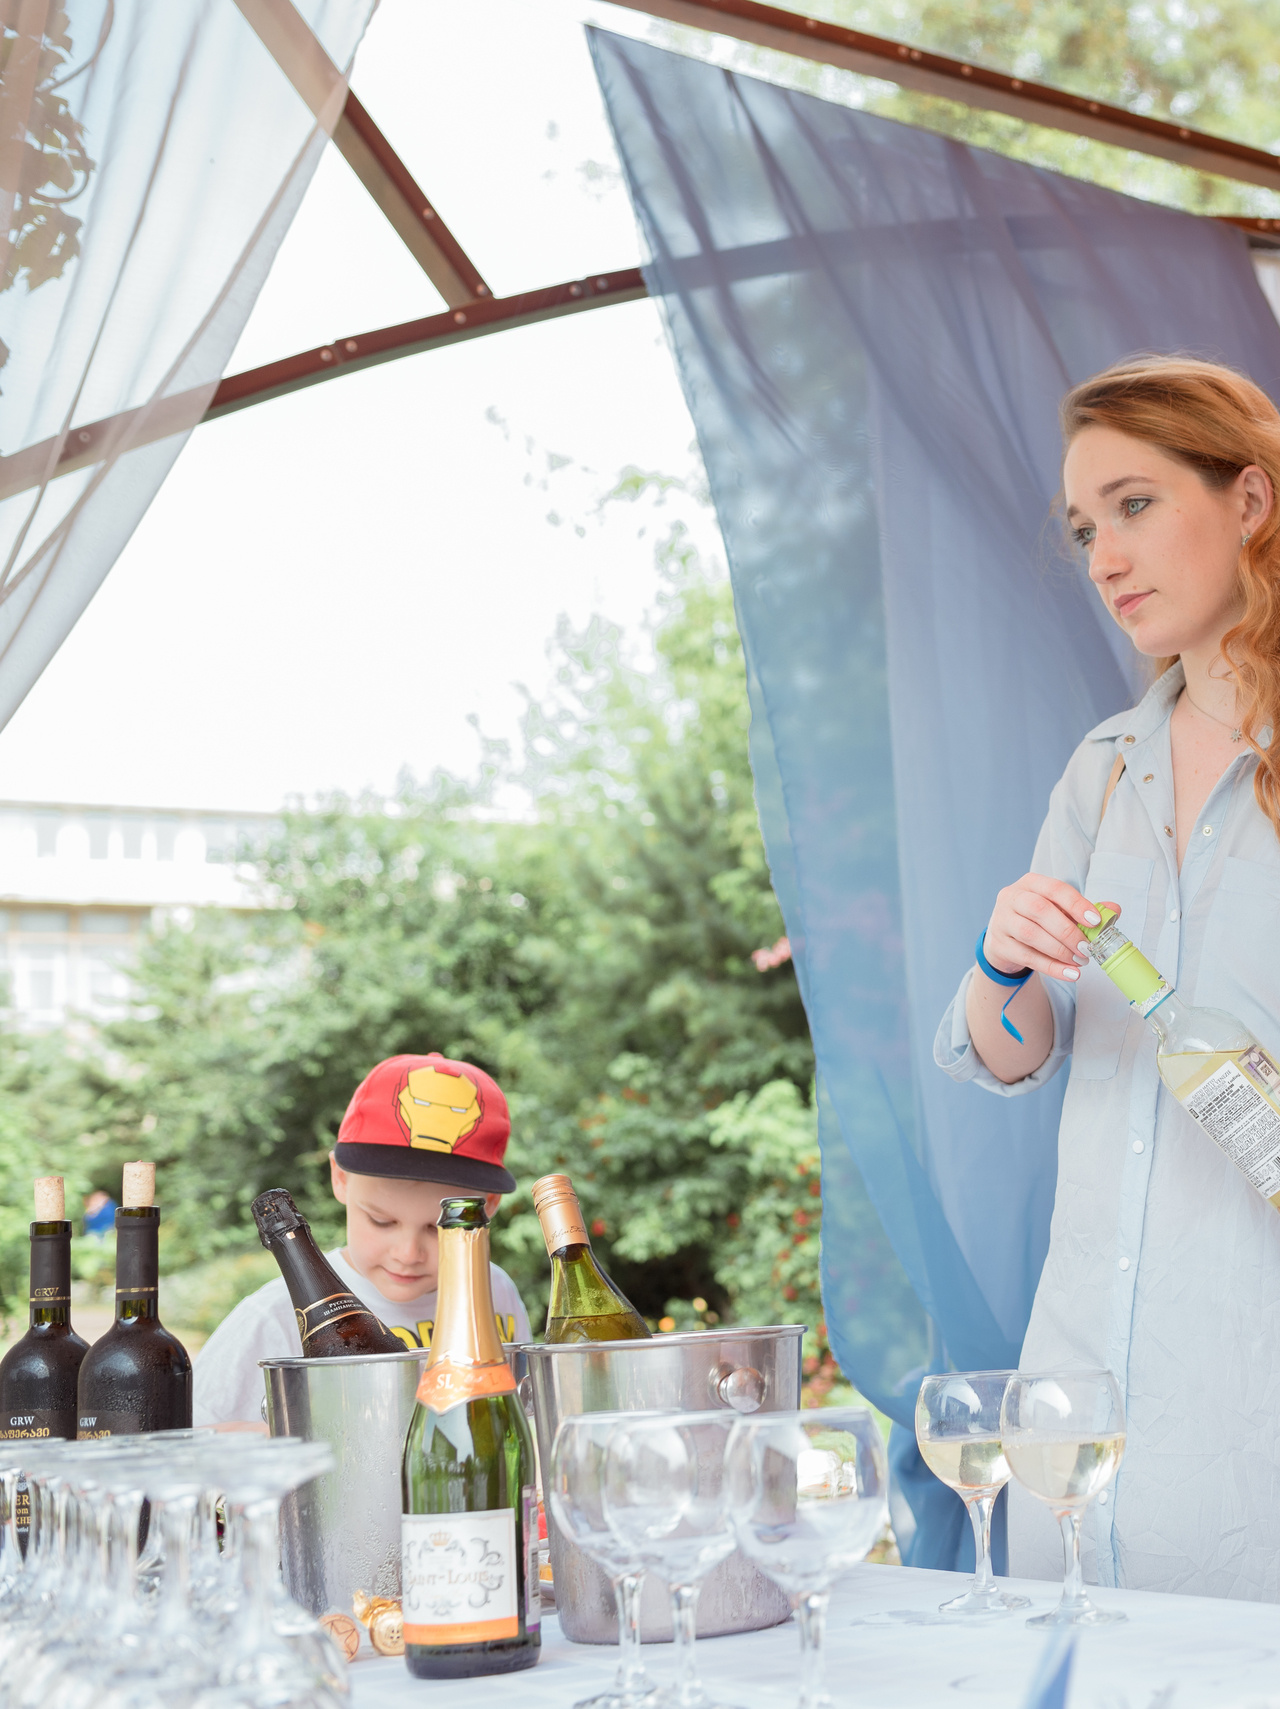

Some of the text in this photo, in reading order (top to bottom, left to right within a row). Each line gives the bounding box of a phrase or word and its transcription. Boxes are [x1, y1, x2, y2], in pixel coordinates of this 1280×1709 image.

[34, 1286, 60, 1297] GRW
[436, 1373, 454, 1390] SL
[10, 1415, 35, 1426] GRW
[79, 1416, 98, 1428] GRW
